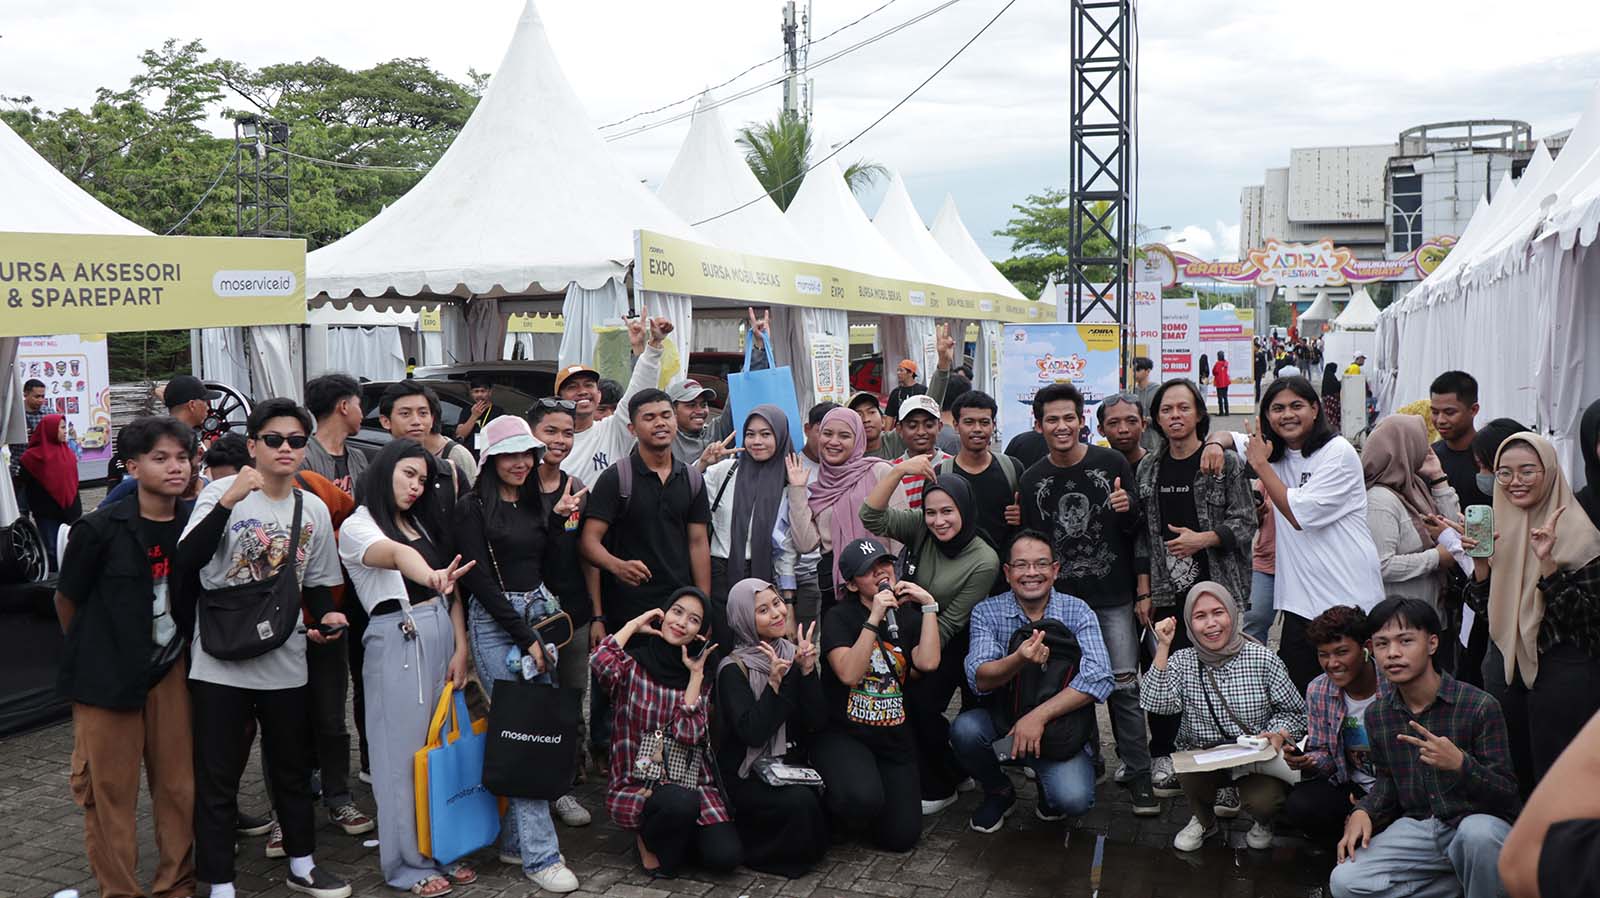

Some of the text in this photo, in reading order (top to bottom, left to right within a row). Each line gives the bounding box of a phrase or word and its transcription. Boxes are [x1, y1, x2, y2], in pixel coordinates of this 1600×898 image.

[1272, 253, 1329, 268] ADIRA
[73, 263, 181, 282] AKSESORI
[649, 258, 675, 278] EXPO
[701, 262, 781, 288] BURSA MOBIL BEKAS
[1186, 262, 1243, 276] GRATIS
[1281, 269, 1320, 277] FESTIVAL
[220, 276, 290, 291] moservice.id
[7, 287, 164, 308] & SPAREPART
[1048, 360, 1076, 370] ADIRA
[852, 696, 871, 710] TIM
[851, 707, 882, 721] ADIRA
[500, 730, 562, 744] moservice.id
